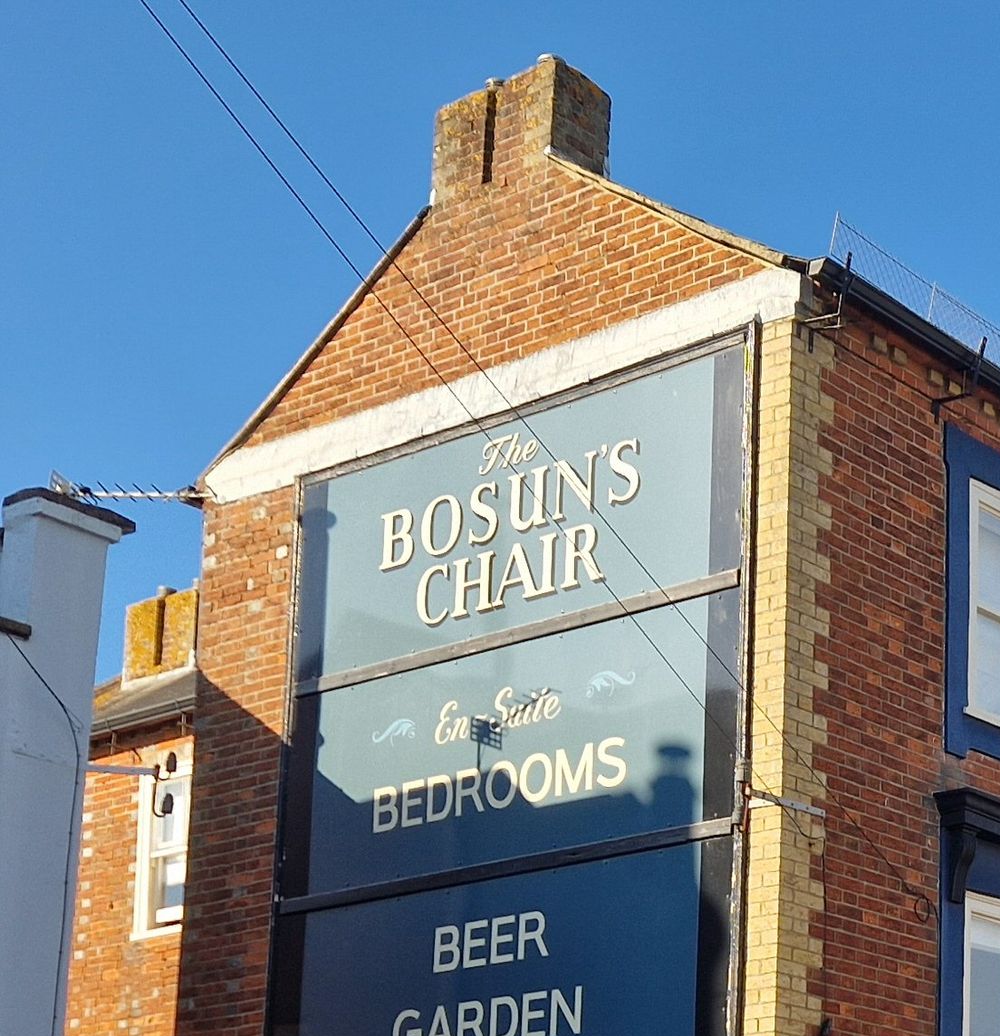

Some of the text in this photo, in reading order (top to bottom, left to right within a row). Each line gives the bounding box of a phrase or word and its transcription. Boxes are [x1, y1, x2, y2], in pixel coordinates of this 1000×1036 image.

[478, 432, 540, 475] The
[379, 438, 641, 572] BOSUN'S
[416, 522, 605, 626] CHAIR
[373, 737, 627, 834] BEDROOMS
[432, 910, 549, 974] BEER
